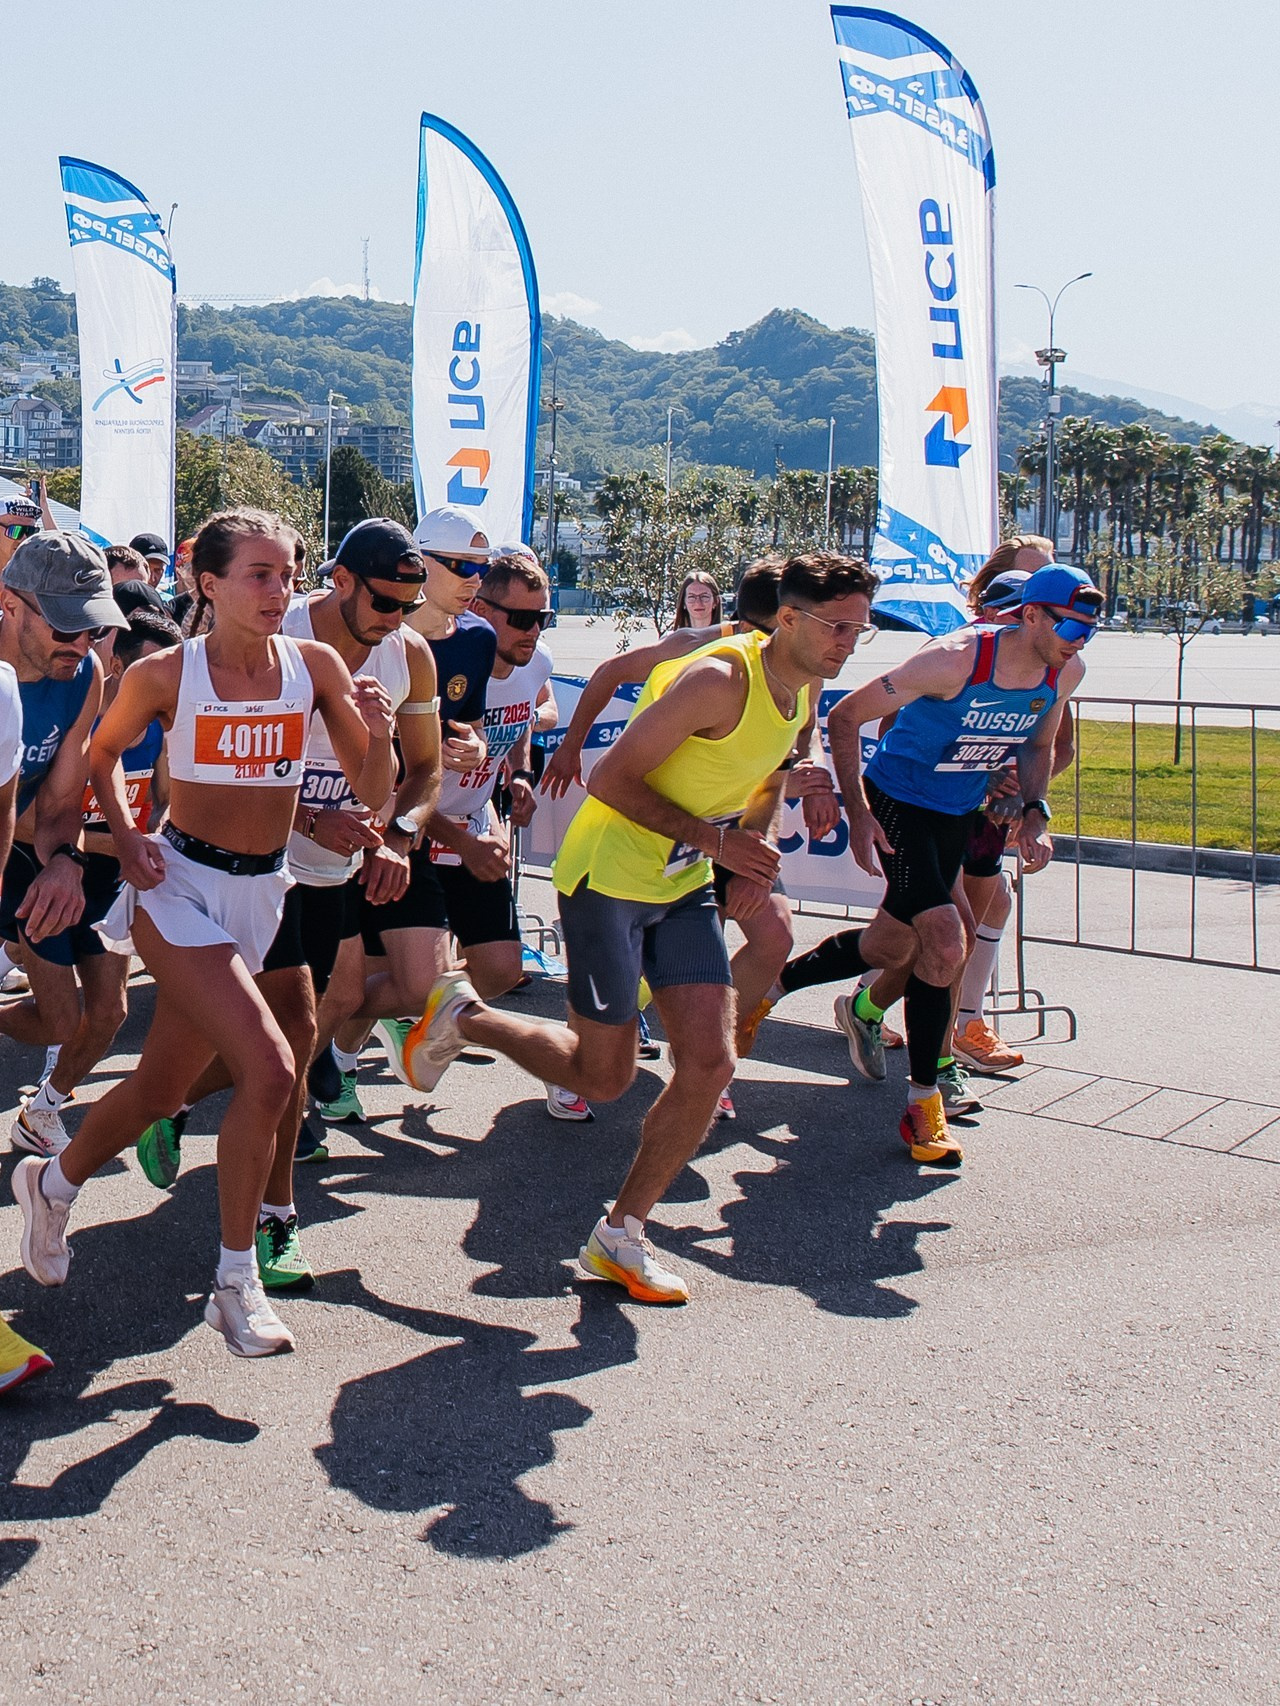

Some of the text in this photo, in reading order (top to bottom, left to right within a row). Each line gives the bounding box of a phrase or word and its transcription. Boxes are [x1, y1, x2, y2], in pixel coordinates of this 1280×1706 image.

[483, 701, 530, 727] БЕГ2025
[961, 710, 1038, 733] RUSSIA
[217, 722, 284, 758] 40111
[952, 745, 1010, 761] 30275
